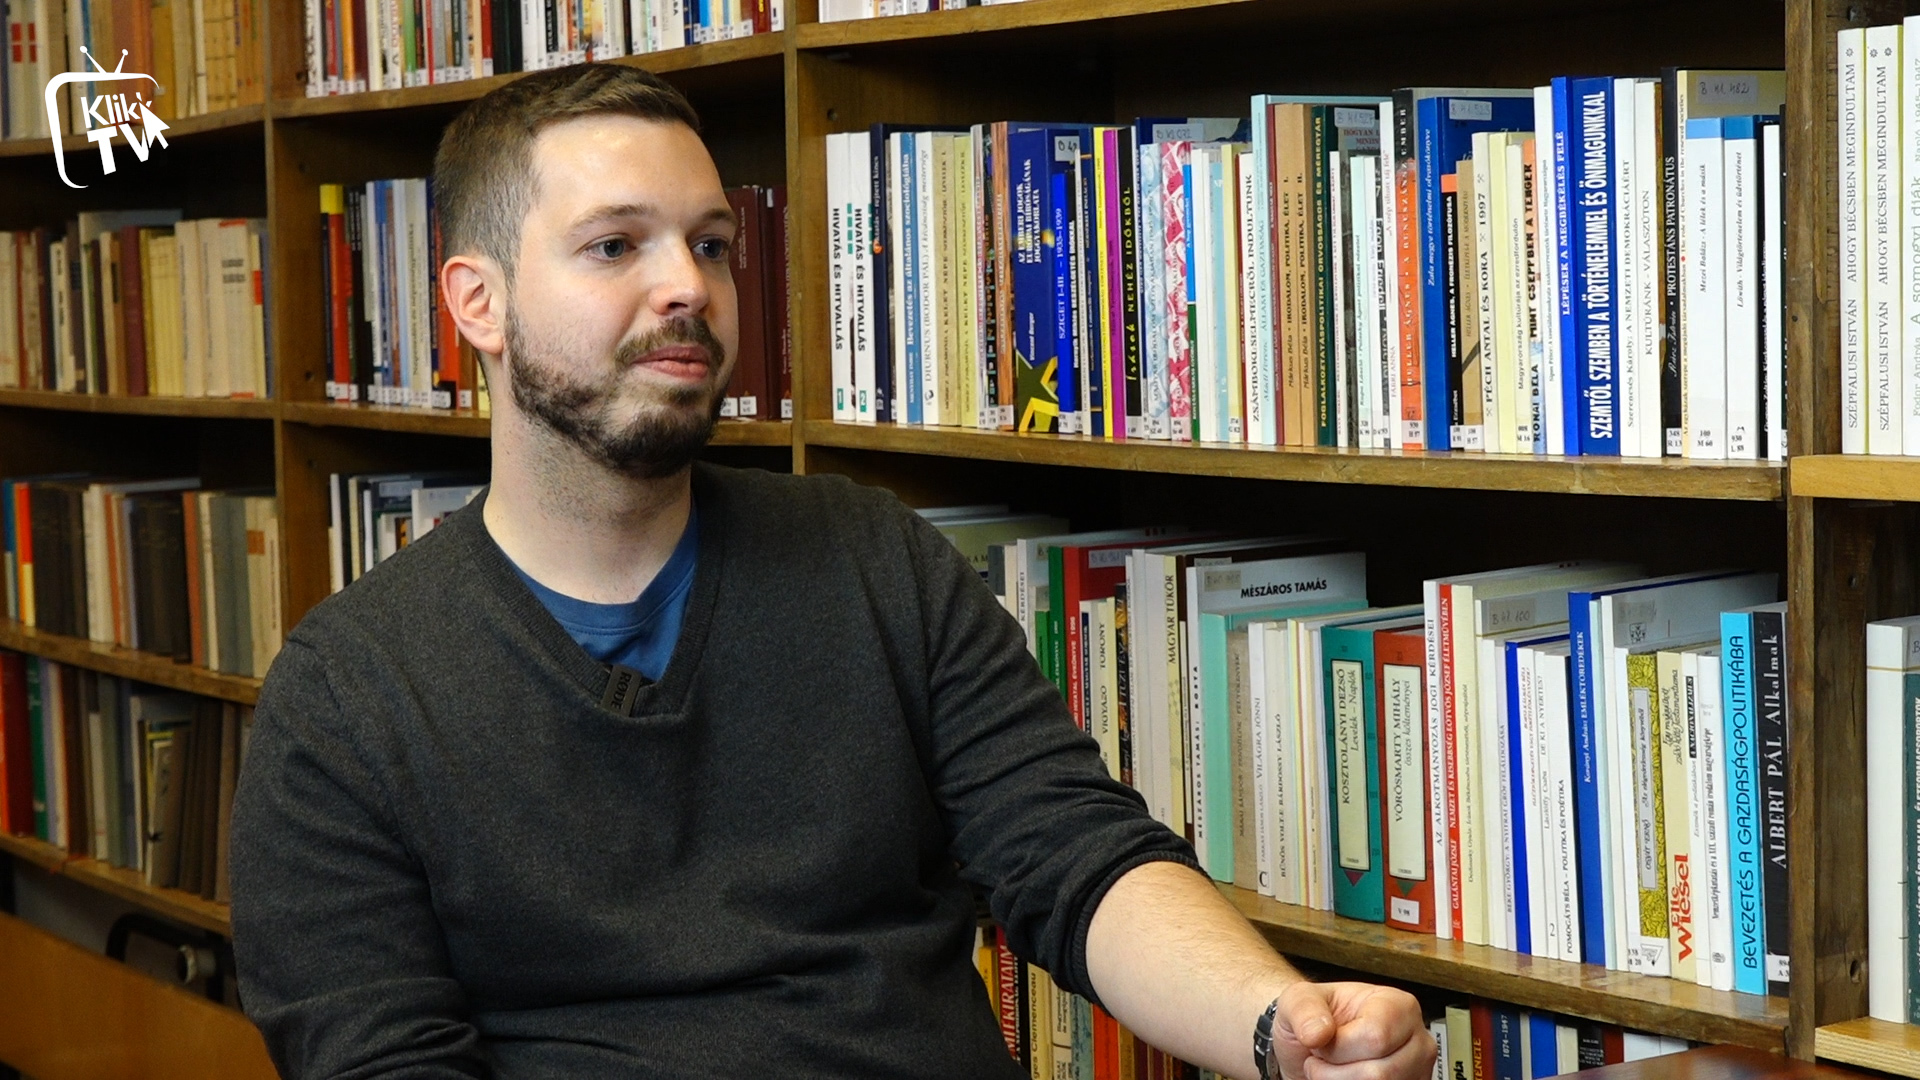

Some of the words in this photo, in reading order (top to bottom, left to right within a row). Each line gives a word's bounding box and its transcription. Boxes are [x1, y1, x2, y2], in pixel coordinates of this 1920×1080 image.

[1579, 91, 1607, 188] ÖNMAGUNKKAL
[1845, 64, 1856, 167] MEGINDULTAM
[1876, 66, 1887, 170] MEGINDULTAM
[1555, 131, 1564, 161] FELÉ
[1245, 175, 1254, 257] INDULTUNK
[1479, 193, 1487, 226] 1997
[1558, 166, 1568, 246] MEGBÉKÉLÉS
[1579, 192, 1608, 205] ÉS
[1664, 156, 1675, 226] PATRONÁTUS
[1845, 171, 1856, 232] BÉCSBEN
[1875, 174, 1887, 234] BÉCSBEN
[833, 208, 842, 259] HIVATÁS
[855, 209, 865, 260] HIVATÁS
[1122, 188, 1133, 254] IDŐKBŐL
[1526, 218, 1533, 226] A
[1641, 190, 1650, 272] VÁLASZÚTON
[834, 265, 844, 279] ÉS
[857, 265, 866, 280] ÉS
[1560, 250, 1568, 259] A
[1581, 209, 1610, 309] TÖRTÉNELEMMEL
[1664, 229, 1676, 296] PROTESTÁNS
[1847, 235, 1857, 282] AHOGY
[1878, 237, 1887, 285] AHOGY
[907, 279, 912, 292] az
[1125, 263, 1134, 311] NEHÉZ
[1481, 296, 1490, 312] ÉS
[1515, 280, 1520, 289] az
[1561, 263, 1570, 314] LÉPÉSEK
[835, 284, 844, 350] HITVALLÁS
[857, 285, 867, 351] HITVALLÁS
[906, 295, 914, 345] Bevezetés
[1483, 317, 1491, 360] ANTAL
[1588, 312, 1609, 321] A
[1644, 282, 1653, 355] KULTÚRÁNK
[1845, 299, 1857, 347] ISTVÁN
[1876, 302, 1889, 349] ISTVÁN
[924, 329, 932, 382] DIURNUS
[1516, 329, 1525, 389] Magyarország
[1588, 325, 1611, 380] SZEMBEN
[1483, 366, 1492, 403] PÉCH
[1846, 350, 1858, 428] SZÉPFALUSI
[1877, 351, 1889, 430] SZÉPFALUSI
[1584, 384, 1612, 438] SZEMTŐL
[1240, 582, 1291, 599] MÉSZÁROS
[1294, 578, 1327, 595] TAMÁS
[1166, 617, 1176, 664] MAGYAR
[1427, 619, 1436, 676] KÉRDÉSEI
[1336, 669, 1347, 709] DEZSŐ
[1349, 669, 1357, 705] Naplók
[1392, 678, 1401, 729] MIHÁLY
[1429, 684, 1439, 711] JOGI
[1762, 635, 1780, 725] Alkalmak
[1351, 714, 1360, 751] Levelek
[1402, 680, 1411, 735] költeményei
[1339, 713, 1350, 804] KOSZTOLÁNYI
[1405, 737, 1413, 766] összes
[1728, 635, 1751, 845] GAZDASÁGPOLITIKÁBA
[1764, 737, 1783, 776] PÁL
[1394, 731, 1403, 822] VÖRÖSMARTY
[1431, 717, 1441, 824] ALKOTMÁNYOZÁS
[1558, 779, 1566, 817] POÉTIKA
[1436, 832, 1442, 846] AZ
[1559, 819, 1567, 829] ÉS
[1768, 787, 1787, 869] ALBERT
[1560, 831, 1568, 870] POLITIKA
[1738, 852, 1752, 864] A
[1564, 903, 1573, 953] POMOGÁTS
[1670, 887, 1679, 928] Elie
[1674, 854, 1692, 962] Wiesel
[1736, 870, 1757, 968] BEVEZETÉS
